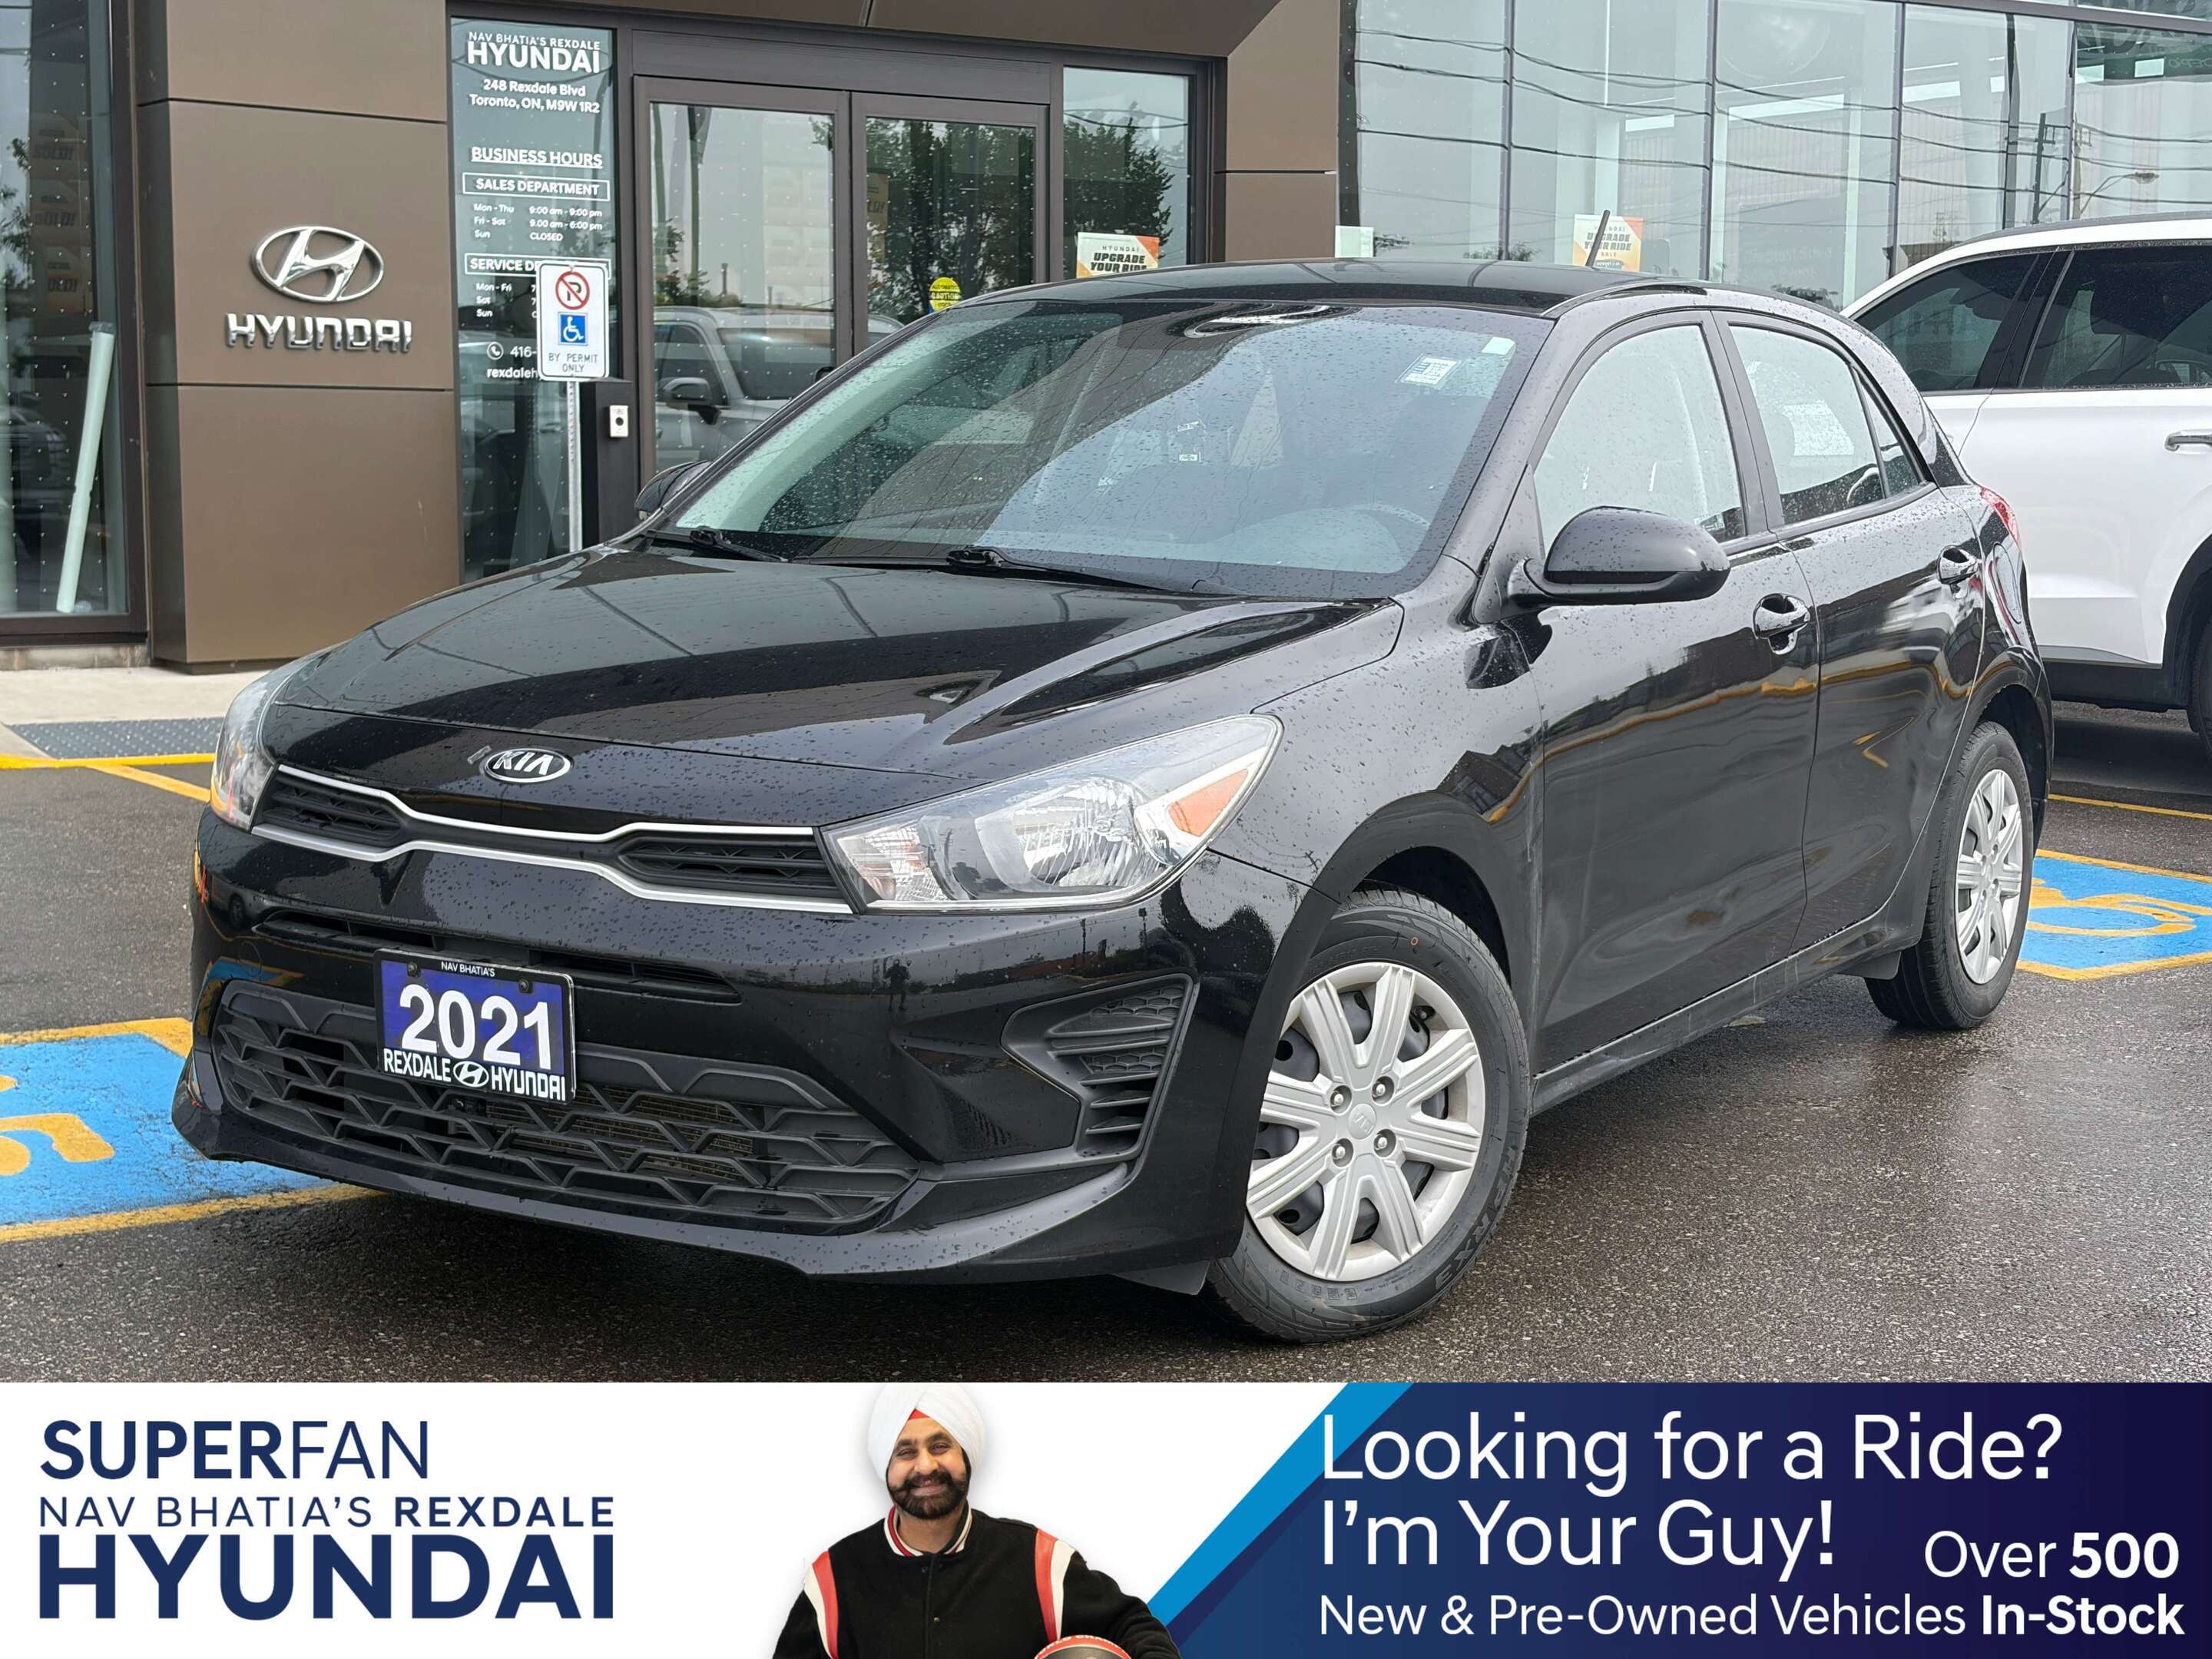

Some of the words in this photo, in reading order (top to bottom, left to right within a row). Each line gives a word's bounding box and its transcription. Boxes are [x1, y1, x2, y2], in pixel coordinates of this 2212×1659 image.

[469, 31, 492, 41] NAV
[496, 34, 546, 46] BHATIA'S
[550, 38, 600, 50] REXDALE
[468, 41, 600, 73] HYUNDAI
[483, 79, 507, 91] 248
[509, 81, 557, 94] Rexdale
[560, 84, 586, 97] Blvd
[469, 94, 520, 109] Toronto,
[522, 98, 545, 111] ON,
[546, 99, 577, 111] M9W
[580, 101, 600, 114] 1R2
[472, 147, 547, 163] BUSINESS
[550, 152, 603, 167] HOURS
[475, 178, 515, 191] SALES
[518, 180, 600, 196] DEPARTMENT
[473, 204, 492, 212] Mon
[474, 216, 485, 225] Fri
[492, 217, 506, 226] Sat
[475, 230, 490, 238] Sun
[530, 232, 563, 241] CLOSED
[1587, 233, 1631, 242] UGRADE
[1584, 241, 1609, 250] YR
[1611, 242, 1632, 251] RIDE
[1094, 253, 1145, 263] UPGRADE
[469, 258, 523, 270] SERVICE
[1091, 262, 1120, 273] YOUR
[476, 283, 495, 291] Mon
[501, 283, 512, 292] Fri
[476, 296, 491, 304] Sat
[476, 309, 493, 317] Sun
[226, 313, 412, 353] HYUNDAI
[548, 353, 560, 362] BY
[567, 353, 598, 363] PERMIT
[562, 363, 584, 373] ONLY
[492, 750, 554, 776] KIA
[441, 962, 458, 972] NAV
[459, 964, 495, 977] BHATIA'S
[400, 984, 551, 1070] 2021
[383, 1048, 452, 1082] REXDALE
[492, 1066, 565, 1101] HYUNDAI
